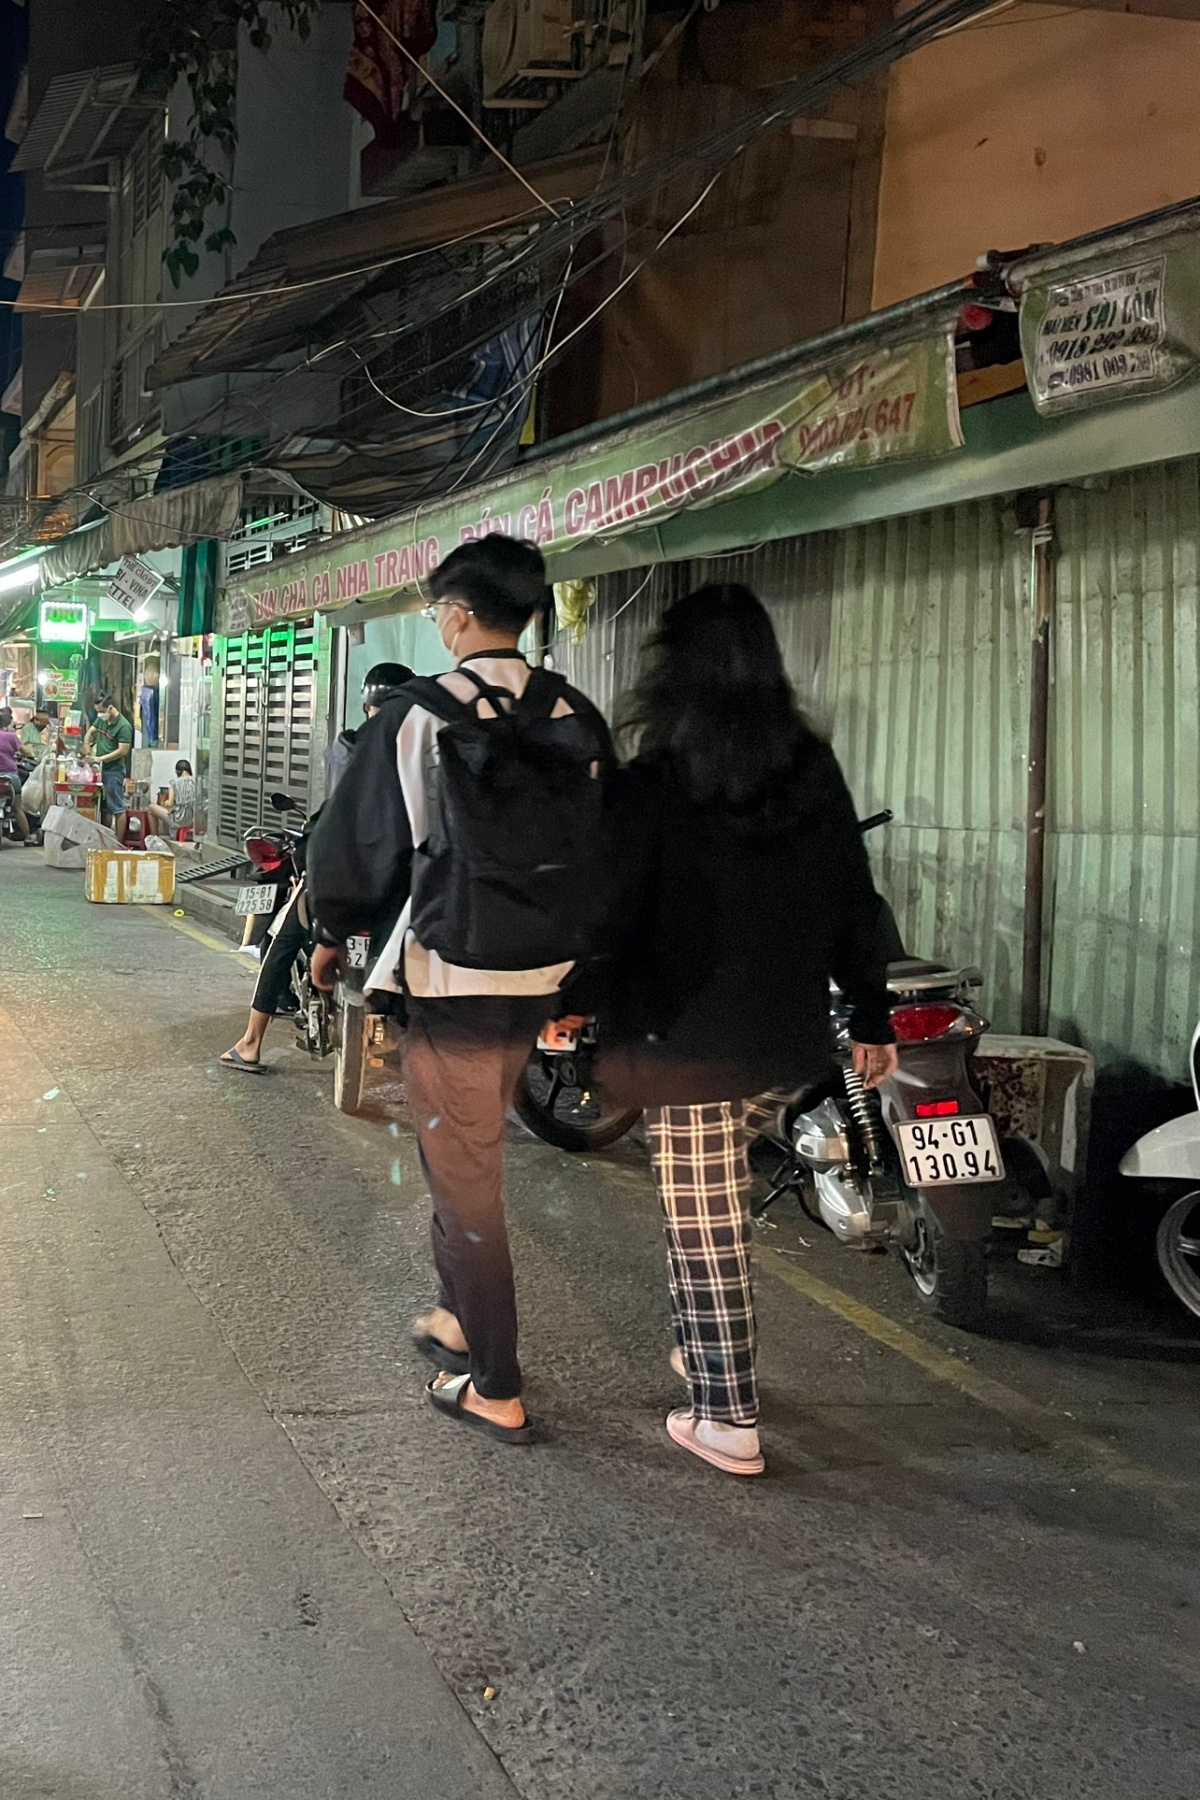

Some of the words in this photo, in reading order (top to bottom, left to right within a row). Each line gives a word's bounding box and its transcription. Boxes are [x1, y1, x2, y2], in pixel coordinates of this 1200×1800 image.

[253, 583, 279, 621] BÚN
[281, 567, 307, 614] CHẢ
[312, 562, 331, 607] CÁ
[336, 559, 370, 603] NHA
[374, 535, 440, 590] TRANG
[518, 486, 555, 546] CÁ
[563, 419, 788, 537] CAMPUCHIA
[129, 579, 149, 599] VINA
[246, 886, 272, 899] 15-B1
[911, 1120, 978, 1150] 94-G1
[909, 1150, 996, 1182] 130.94
